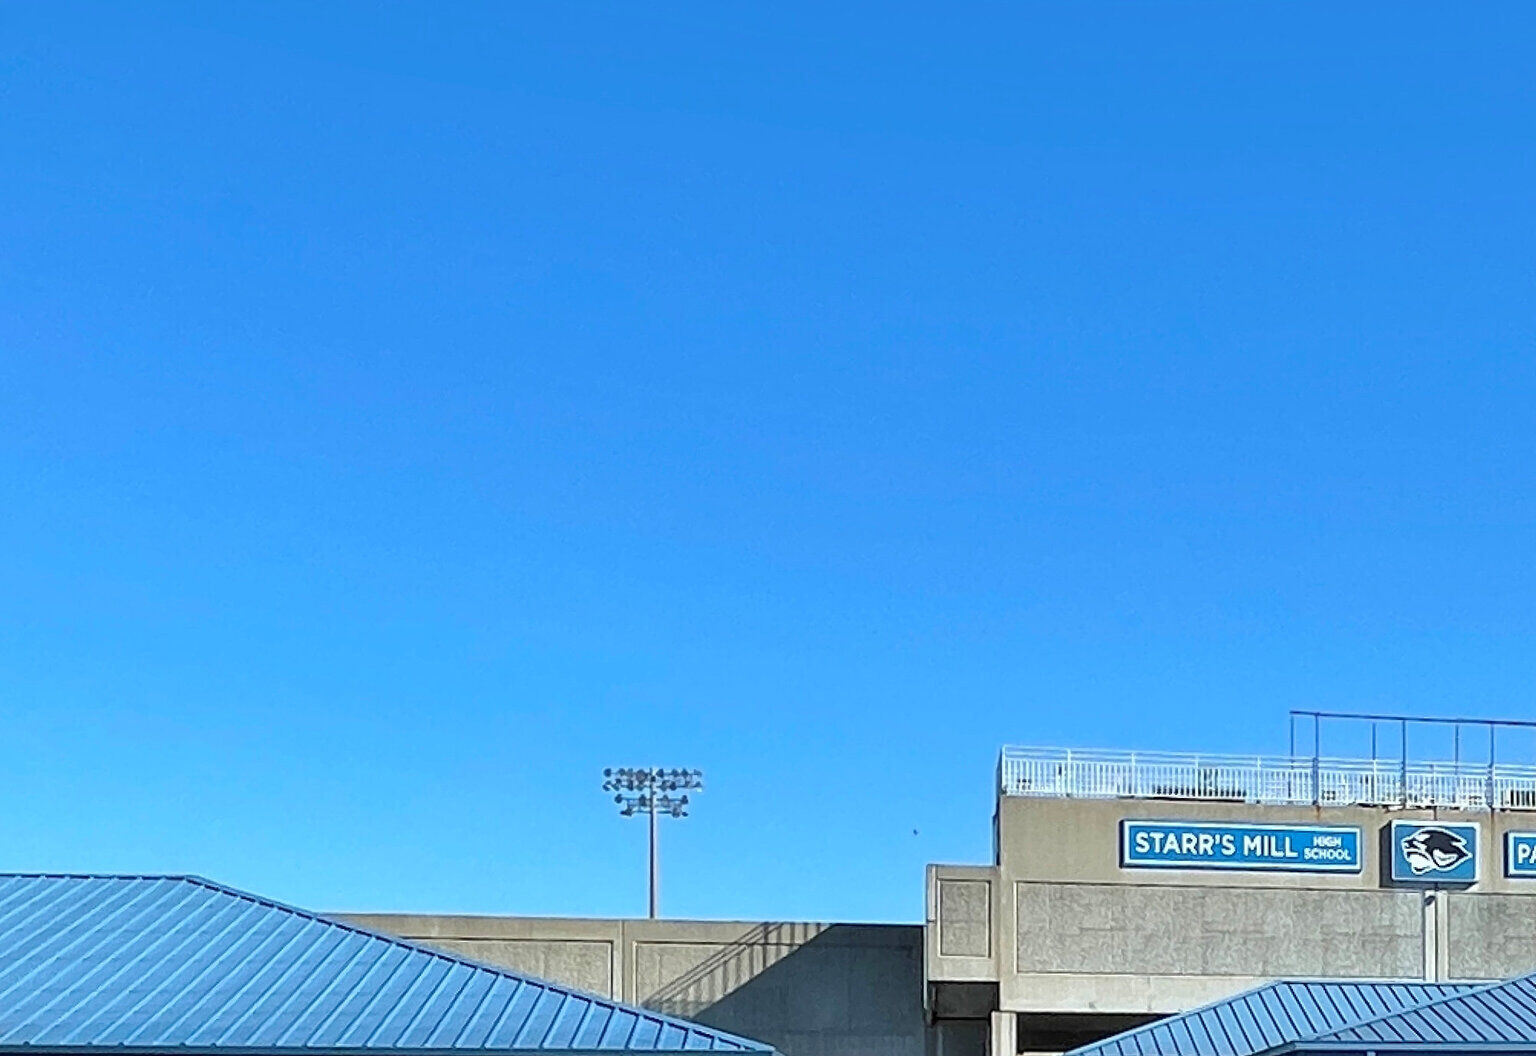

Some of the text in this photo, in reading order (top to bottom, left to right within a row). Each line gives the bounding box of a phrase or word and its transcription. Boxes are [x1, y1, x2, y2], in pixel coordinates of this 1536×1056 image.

[1134, 831, 1299, 858] STARR'S MILL
[1312, 836, 1342, 847] HIGH
[1303, 847, 1352, 861] SCHOOL
